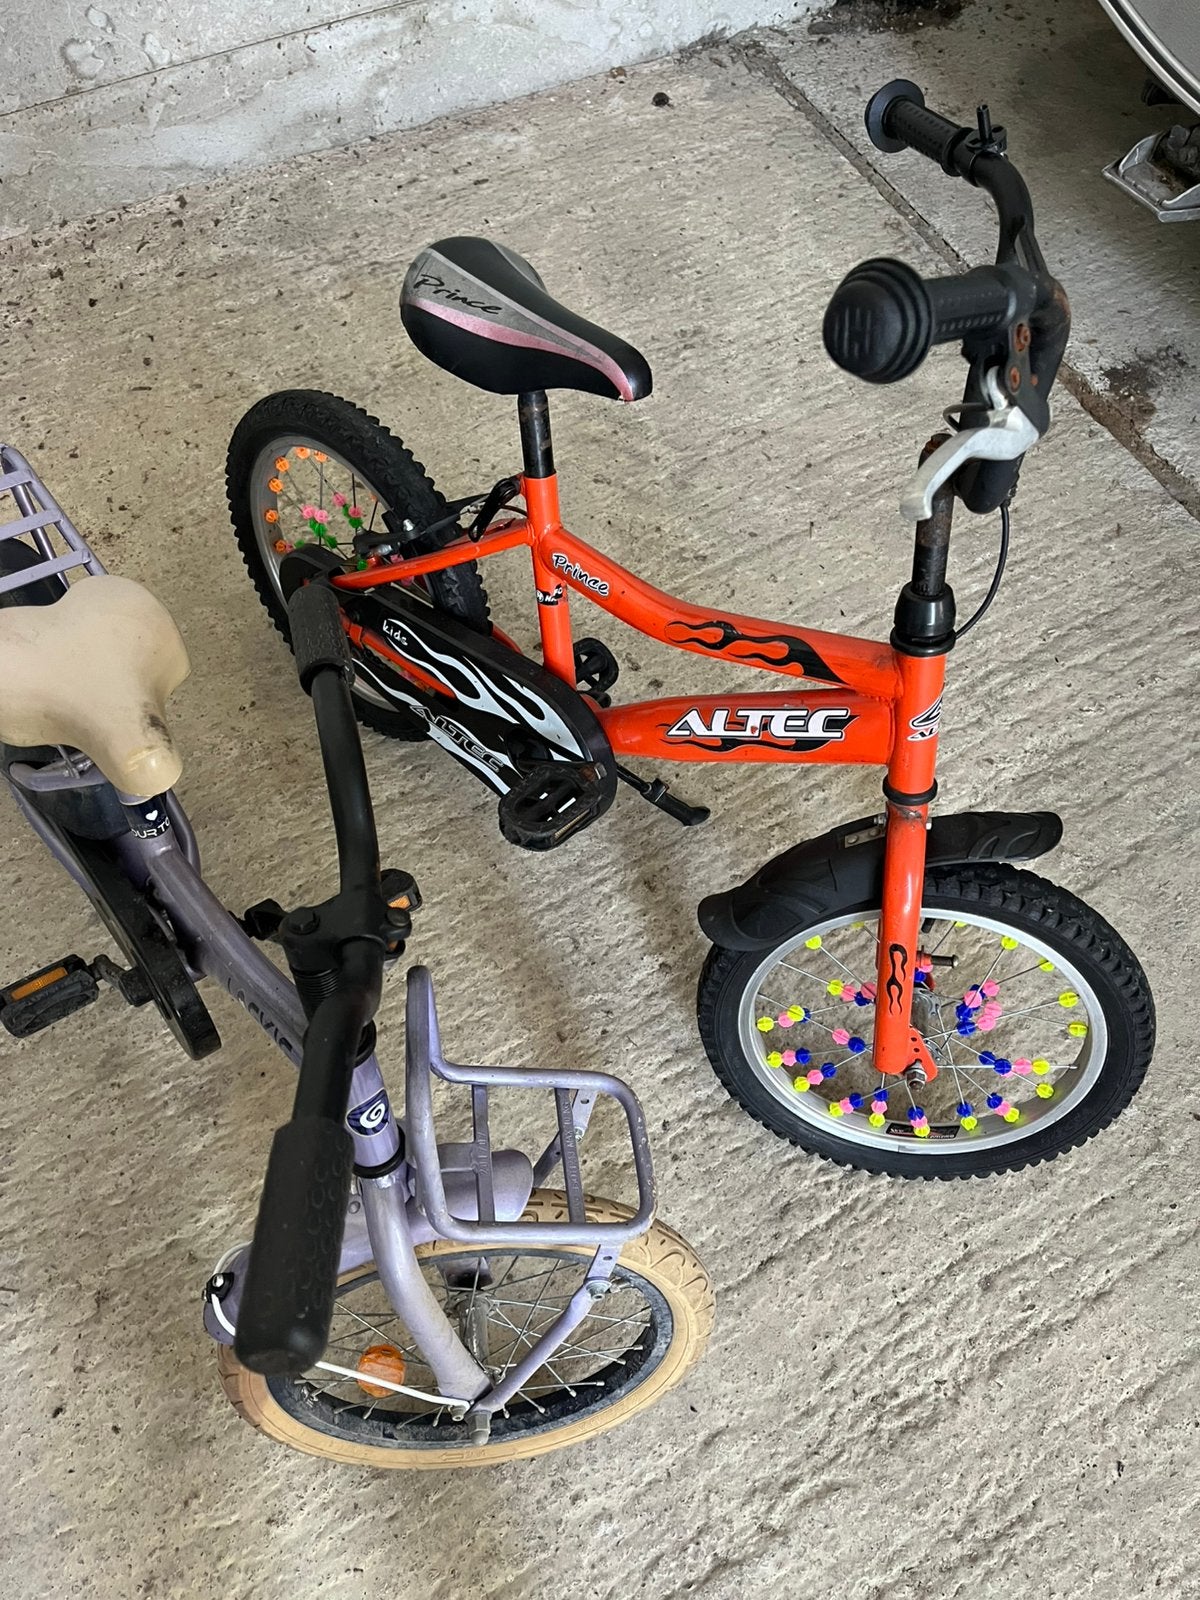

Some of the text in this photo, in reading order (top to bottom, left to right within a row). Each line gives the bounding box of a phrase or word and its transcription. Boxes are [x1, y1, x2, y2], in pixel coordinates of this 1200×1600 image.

[413, 274, 503, 315] Prince
[552, 553, 609, 596] Prince
[383, 619, 409, 646] kids
[410, 705, 504, 773] ALTEC
[666, 708, 849, 739] ALTEC
